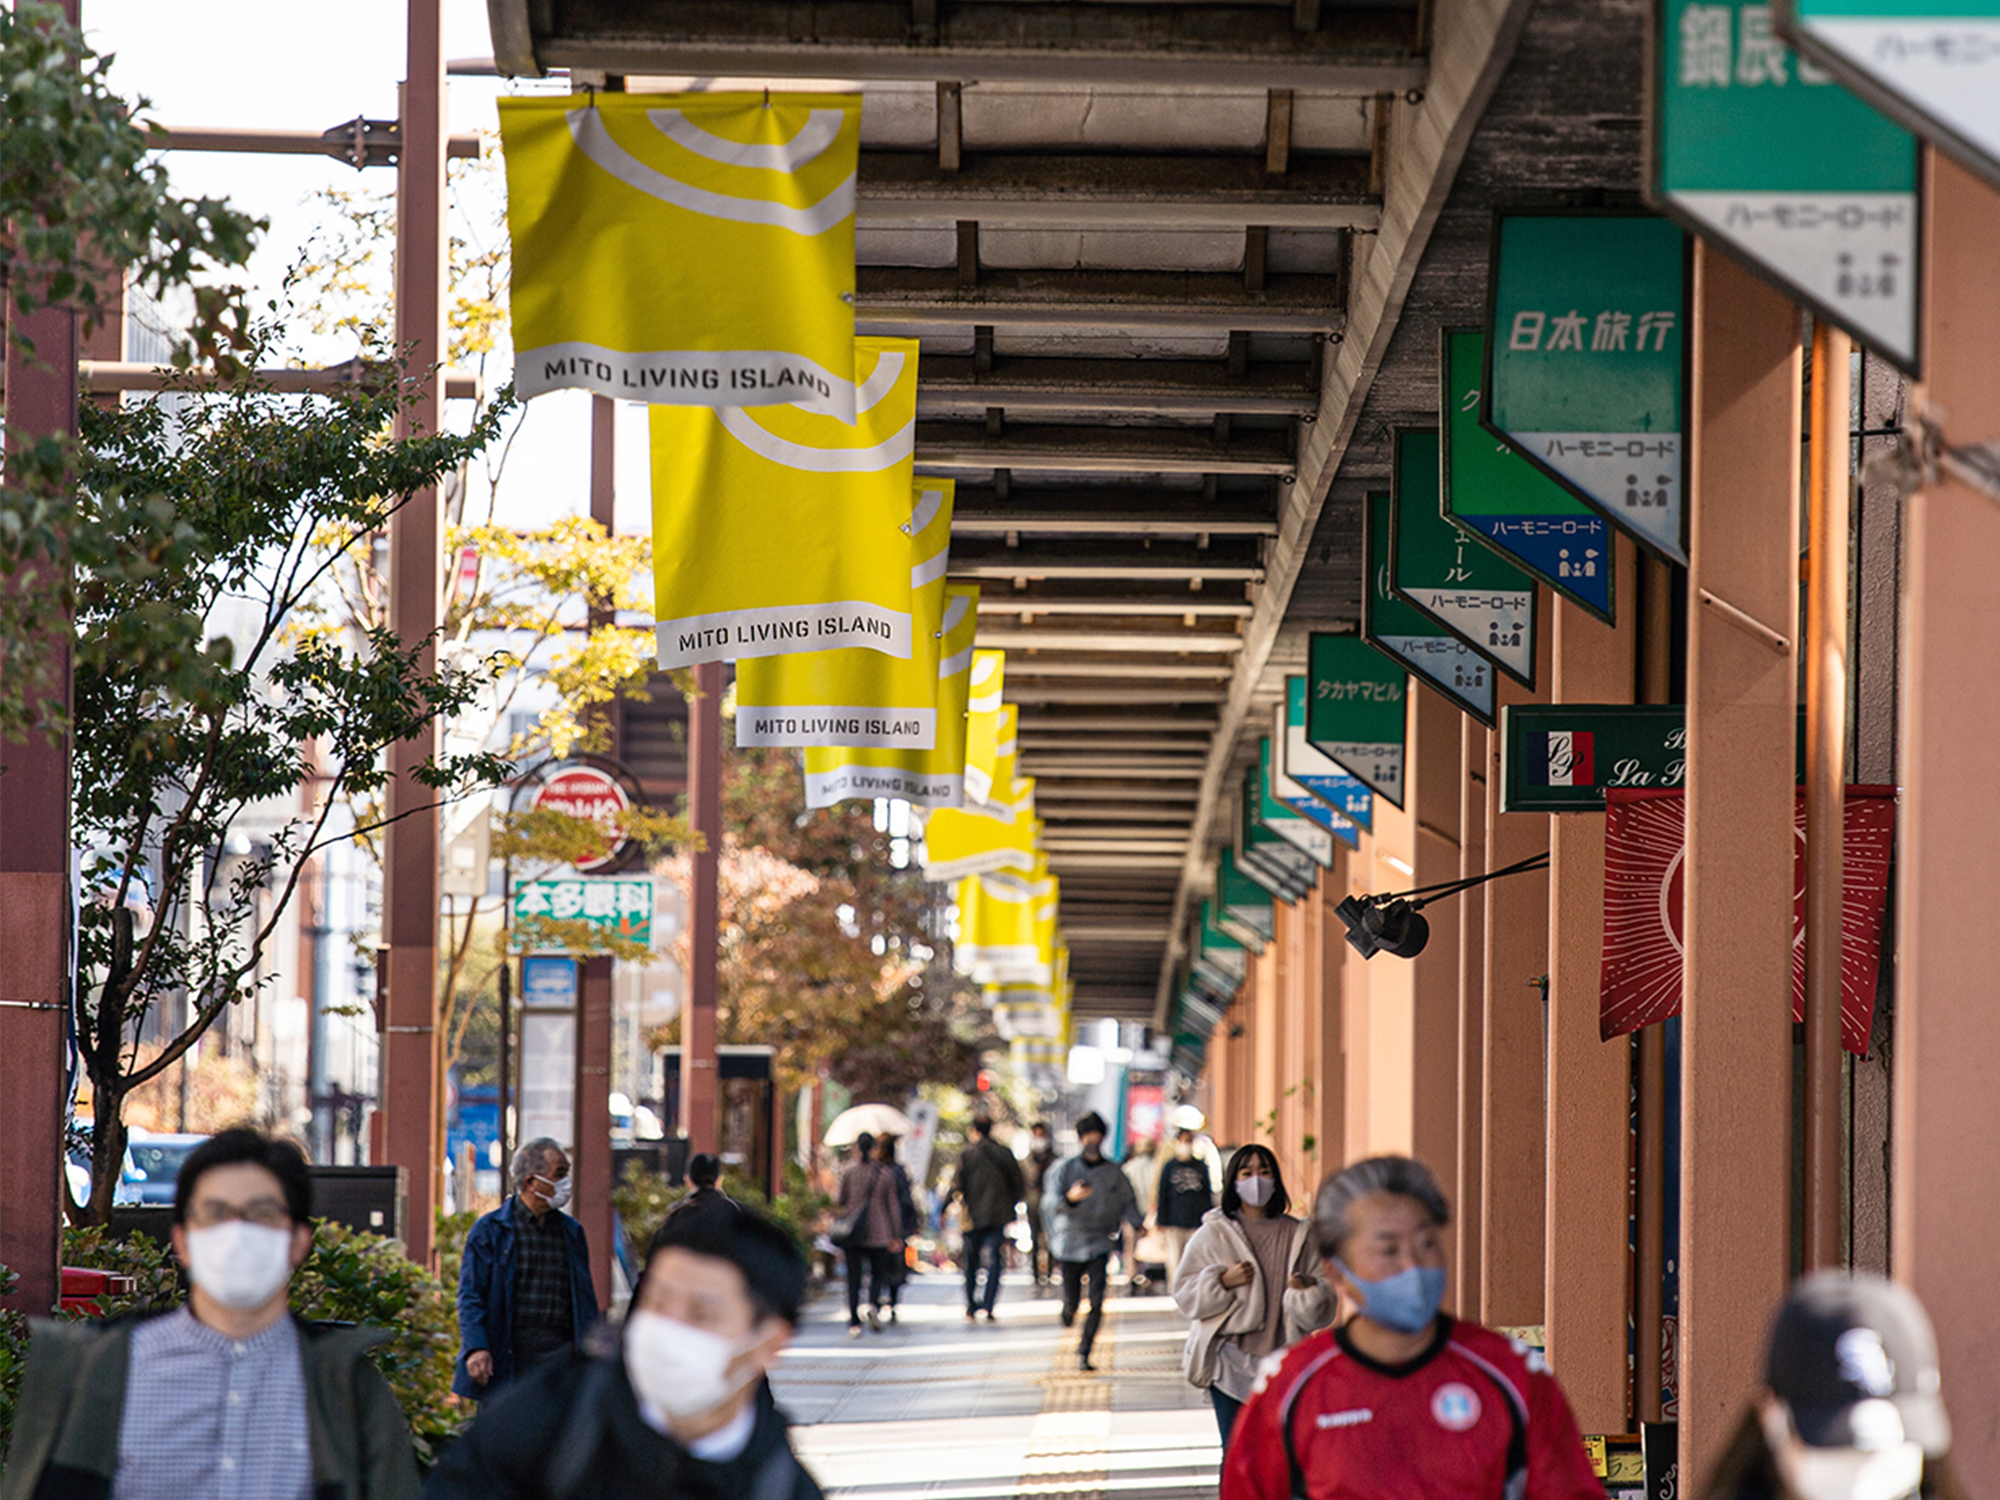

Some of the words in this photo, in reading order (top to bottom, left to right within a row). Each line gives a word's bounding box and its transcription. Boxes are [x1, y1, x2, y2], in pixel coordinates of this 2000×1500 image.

[1508, 309, 1676, 352] 日本旅行
[545, 357, 612, 382] MITO
[623, 368, 719, 390] LIVING
[730, 367, 830, 398] ISLAND
[1547, 439, 1675, 459] ハーモニーロード
[1492, 520, 1602, 536] ハーモニーロード
[1430, 594, 1526, 610] ハーモニーロード
[678, 627, 729, 652] MITO
[737, 620, 809, 644] LIVING
[817, 615, 891, 640] ISLAND
[1316, 678, 1402, 703] タカヤマビル
[754, 719, 796, 734] MITO
[801, 719, 860, 735] LIVING
[865, 720, 920, 736] ISLAND
[1606, 758, 1656, 787] La
[821, 778, 848, 796] MITO
[851, 776, 902, 791] LIVING
[904, 780, 951, 797] ISLAND
